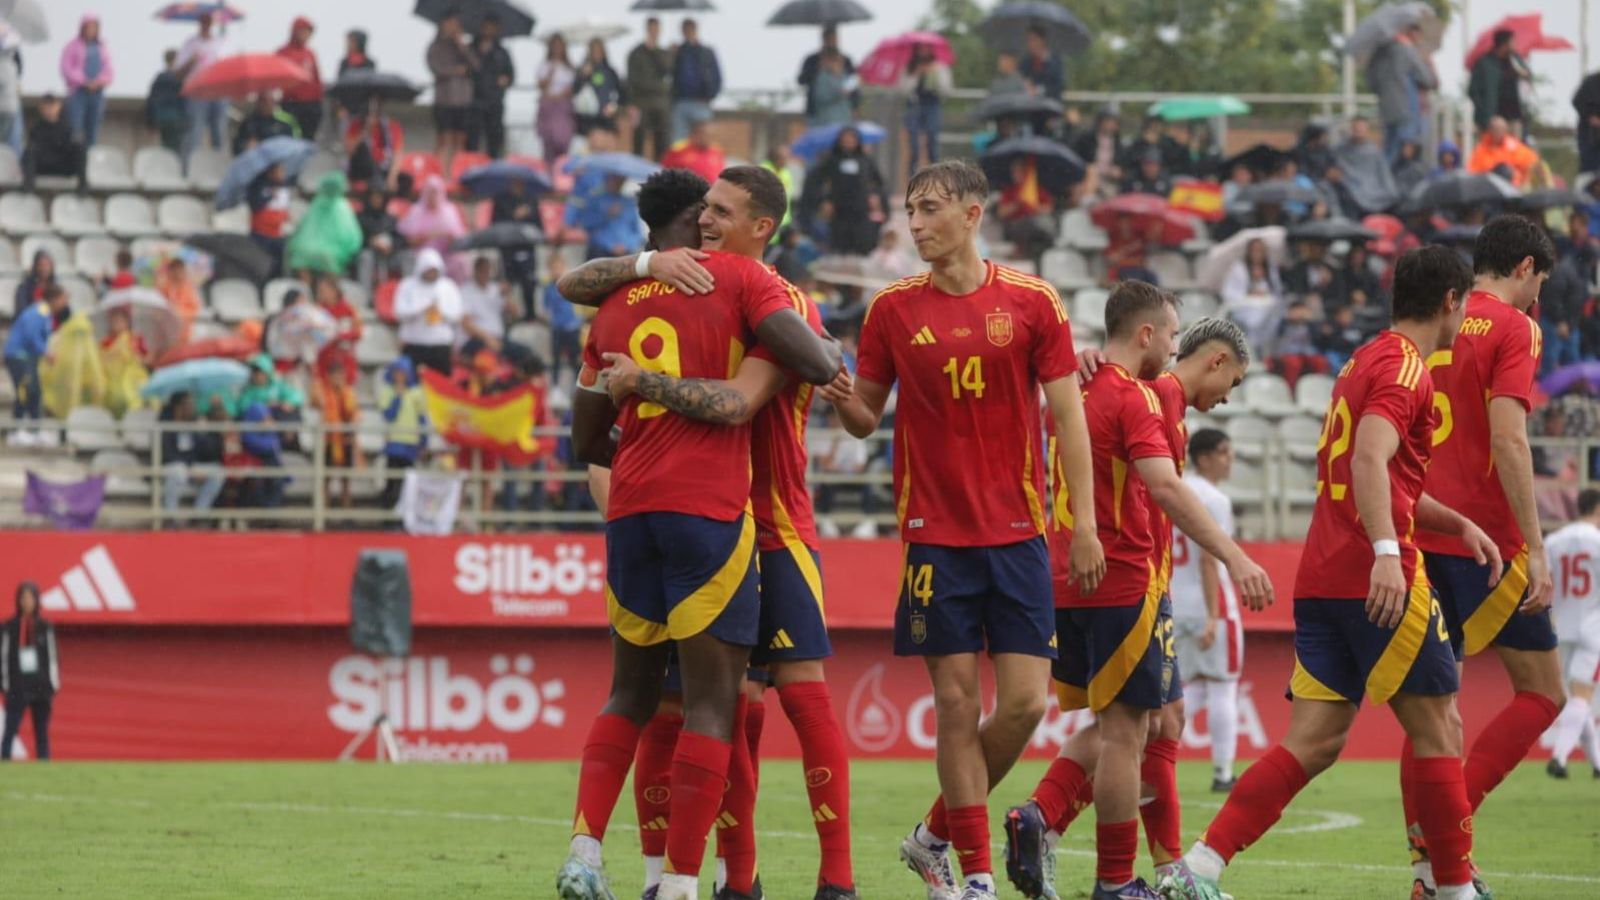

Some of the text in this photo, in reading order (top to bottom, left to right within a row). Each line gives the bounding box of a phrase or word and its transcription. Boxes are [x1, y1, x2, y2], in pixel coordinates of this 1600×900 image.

[628, 316, 683, 419] 9
[943, 356, 985, 399] 14
[906, 564, 934, 607] 14
[1560, 553, 1591, 598] 15
[490, 594, 569, 617] Telecom
